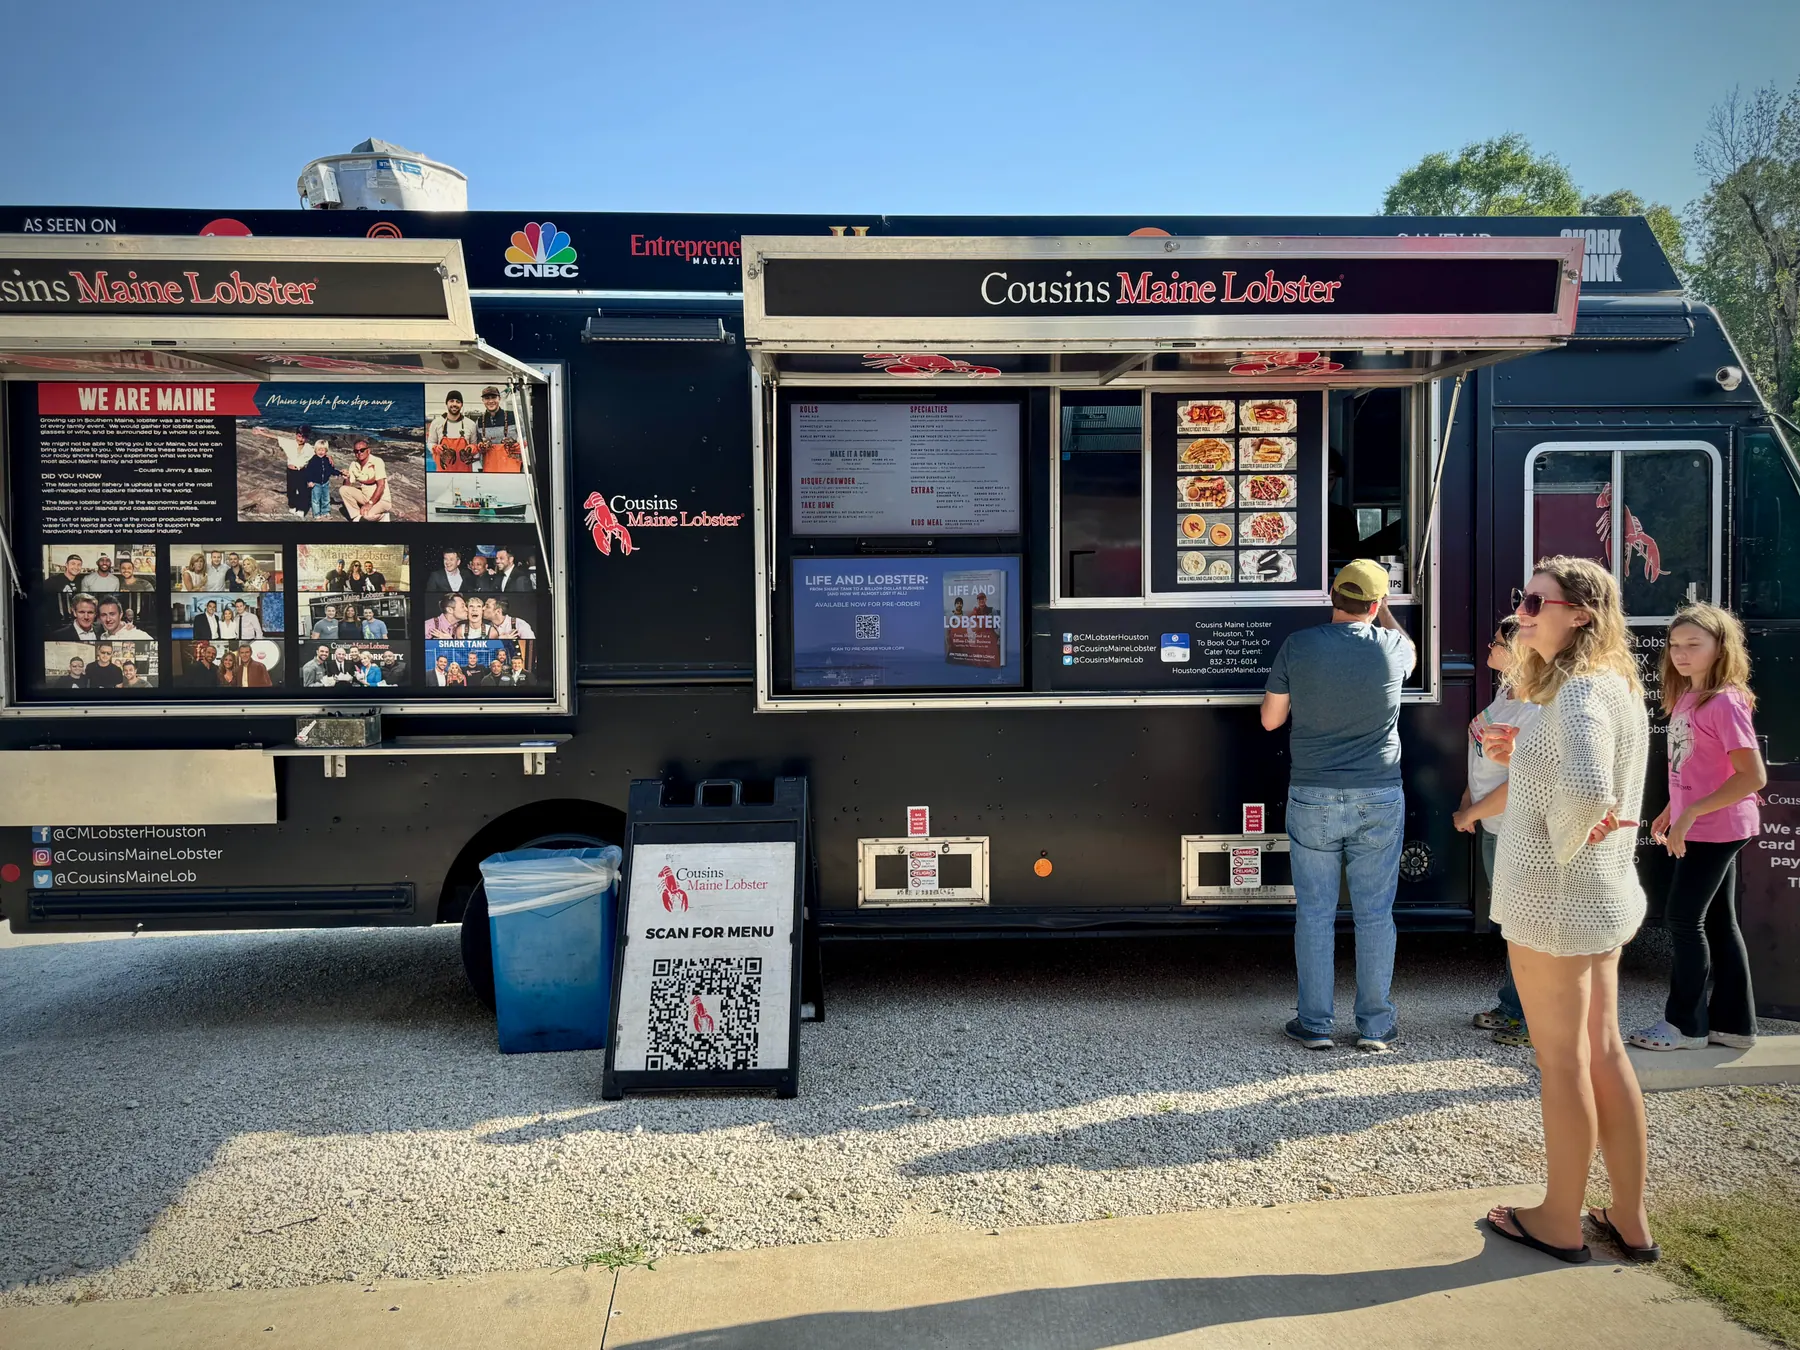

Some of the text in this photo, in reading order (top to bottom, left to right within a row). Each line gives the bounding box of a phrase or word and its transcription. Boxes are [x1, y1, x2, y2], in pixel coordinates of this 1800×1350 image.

[24, 219, 116, 232] AS SEEN ON
[631, 234, 742, 261] Entreprene
[504, 264, 579, 278] CNBC
[0, 269, 69, 303] sins
[69, 271, 184, 304] Maine
[981, 271, 1111, 306] Cousins
[1116, 272, 1216, 304] Maine
[78, 388, 215, 411] WE ARE MAINE
[266, 395, 298, 406] Maine
[304, 395, 326, 413] just
[332, 396, 350, 410] few
[351, 395, 370, 410] steps
[371, 400, 395, 412] away
[610, 494, 677, 513] Cousins
[626, 511, 678, 527] Maine
[806, 575, 928, 585] LIFE AND LOBSTER:
[948, 584, 995, 596] LIFE AND
[944, 615, 1001, 628] LOBSTER
[1636, 636, 1665, 647] Lobs
[1073, 644, 1156, 653] @CousinsMaineLobster
[1073, 656, 1143, 664] @CousinsMaineLob
[1768, 794, 1800, 805] Cous
[53, 826, 206, 841] @CMLobsterHouston
[1763, 823, 1790, 834] We
[1759, 840, 1795, 850] card
[54, 848, 223, 864] @CousinsMaineLobster
[1771, 857, 1800, 868] pay
[55, 870, 197, 887] @CousinsMaineLob
[676, 867, 724, 881] Cousins
[688, 879, 768, 891] Maine Lobster
[646, 926, 774, 939] SCAN FOR MENU
